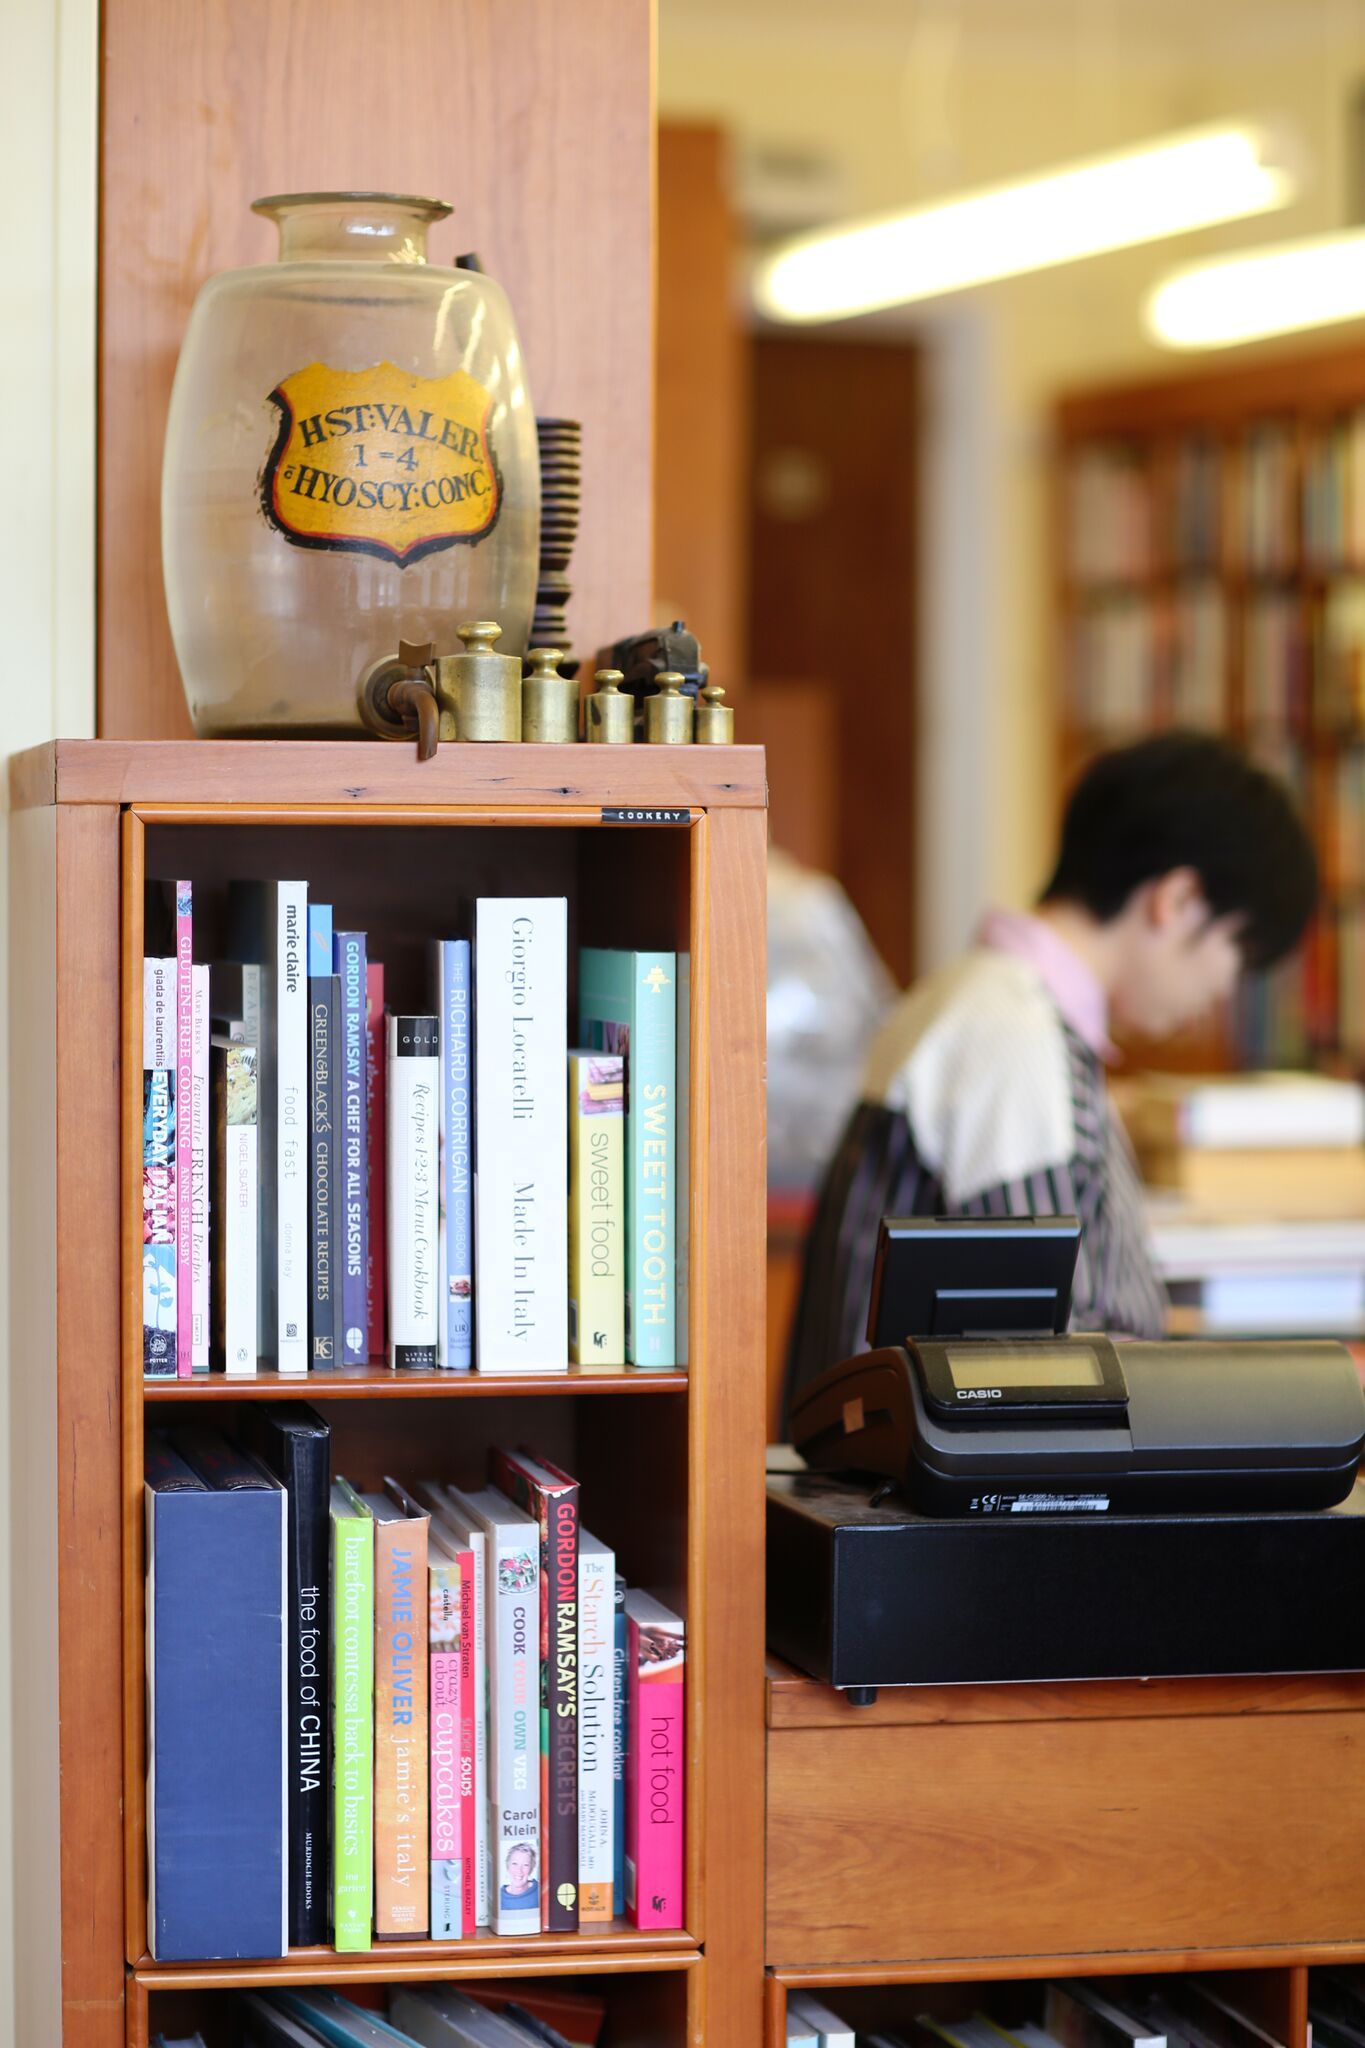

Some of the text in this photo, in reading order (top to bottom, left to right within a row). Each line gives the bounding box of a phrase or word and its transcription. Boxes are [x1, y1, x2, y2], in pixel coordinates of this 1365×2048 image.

[618, 812, 680, 820] COOKERY
[286, 905, 299, 993] marie claire
[154, 969, 165, 1067] giada de laurentiis
[194, 990, 203, 1013] MARY
[402, 1036, 439, 1044] GOLD
[505, 917, 535, 1121] Giorgio Locatelli
[179, 936, 191, 1266] GLUTEN-FREE COOKING ANNE SHEASBY
[284, 1086, 299, 1179] food fast
[346, 941, 361, 1276] GORDON RAMSAY A CHEF FOR ALL SEASONS
[411, 1083, 431, 1144] Recipes
[450, 962, 467, 1269] THE RICHARD CORRIGAN COOKBOOK
[643, 1084, 667, 1201] SWEET
[152, 1071, 168, 1243] EVERYDAY ITALIAN
[192, 1075, 205, 1284] Favourite FRENCH Recipes
[239, 1133, 248, 1166] NIGEL
[239, 1168, 248, 1208] SLATER
[316, 1142, 329, 1237] CHOCOLATE
[413, 1188, 429, 1235] Menu
[591, 1132, 615, 1277] sweet food
[282, 1223, 294, 1278] donna hay
[316, 1241, 329, 1301] RECIPES
[413, 1237, 430, 1320] Cookbook
[507, 1181, 535, 1343] Made In Italy
[643, 1208, 667, 1325] TOOTH
[956, 1389, 1002, 1399] CASIO
[391, 1547, 413, 1623] JAMIE
[441, 1588, 453, 1621] castella
[461, 1580, 471, 1678] Michael van Straten
[300, 1586, 320, 1793] the food of CHINA
[344, 1536, 366, 1856] barefoot contessa back to basics
[391, 1631, 413, 1726] OLIVER
[434, 1659, 447, 1708] about
[447, 1659, 459, 1706] crazy
[513, 1607, 526, 1791] COOK YOUR OWN VEG
[556, 1503, 576, 1816] GORDON RAMSAY'S SECRETS
[583, 1563, 606, 1773] The Starch Solution
[390, 1734, 416, 1823] jamie's
[431, 1713, 460, 1852] cupcakes
[502, 1808, 537, 1821] Carol
[651, 1717, 675, 1824] hot food
[391, 1834, 416, 1888] italy
[503, 1824, 537, 1837] Klein
[599, 1808, 608, 1836] JOHN
[443, 1885, 451, 1919] STERLING
